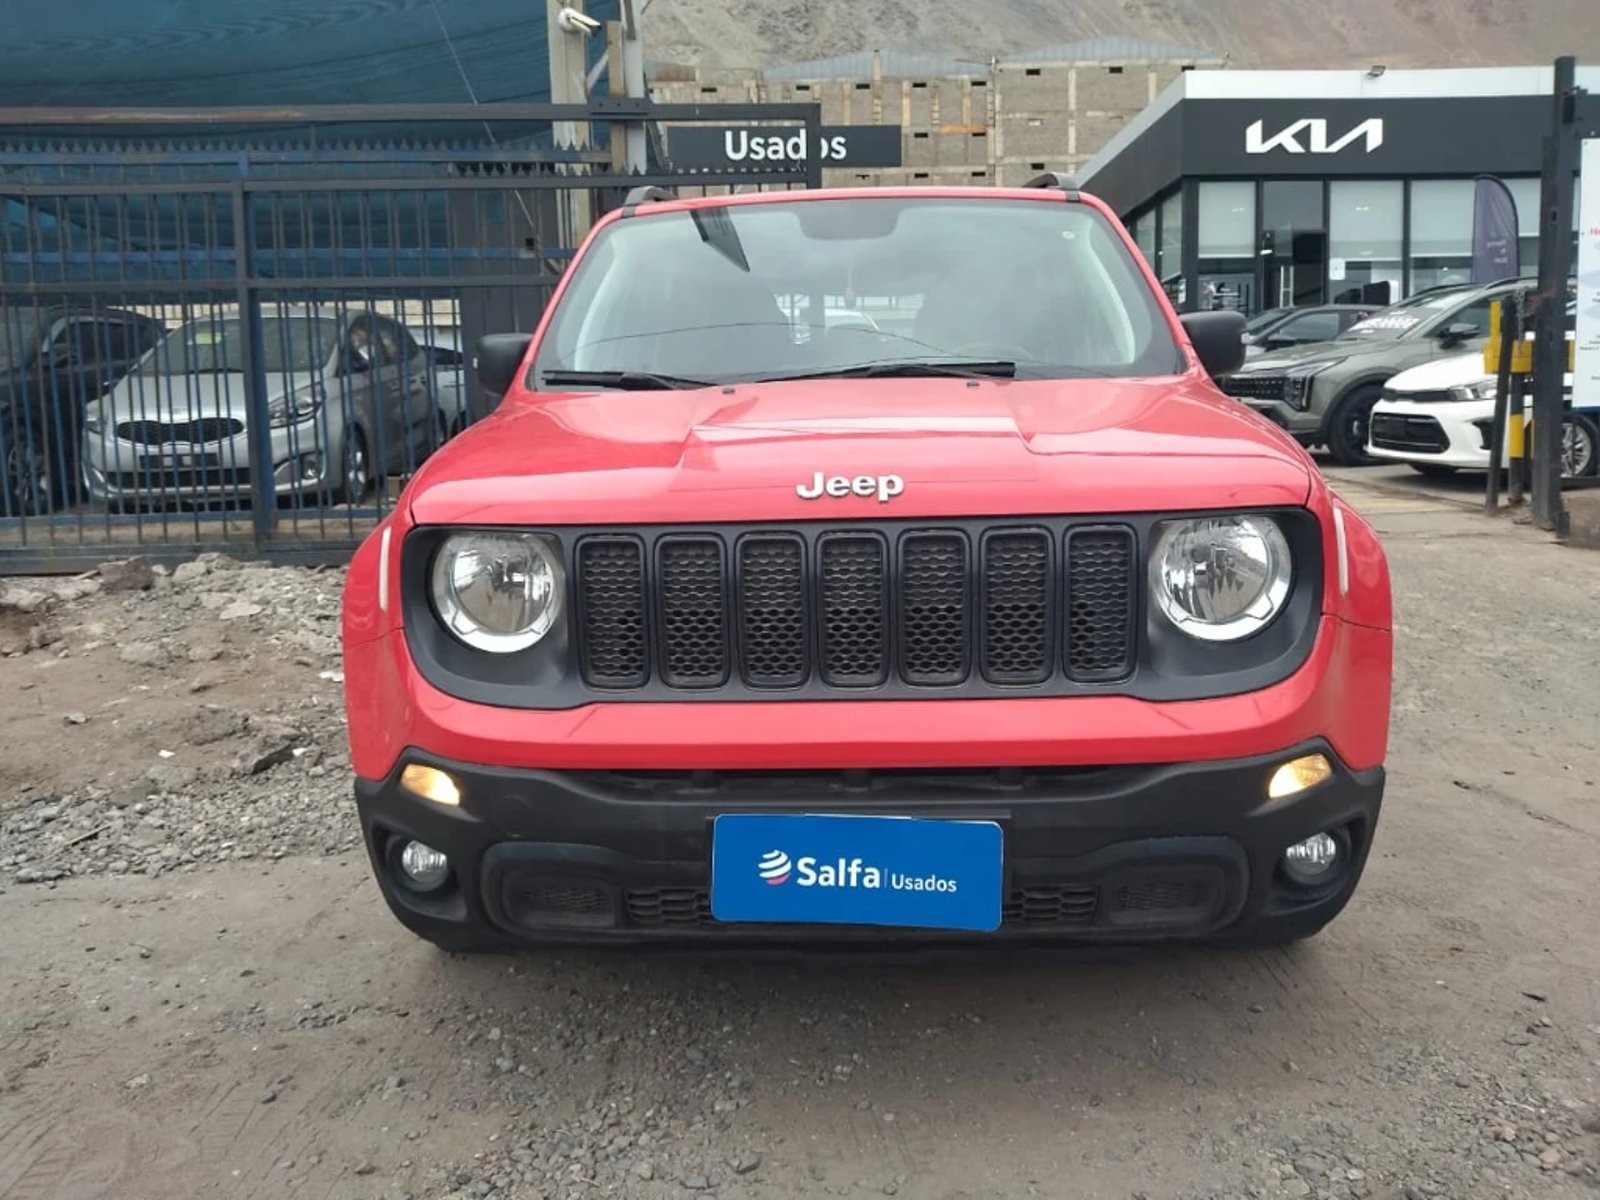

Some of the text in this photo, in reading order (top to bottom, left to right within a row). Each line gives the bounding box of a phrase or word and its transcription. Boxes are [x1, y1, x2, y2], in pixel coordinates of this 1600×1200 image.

[1245, 118, 1383, 154] KIA
[796, 471, 905, 503] Jeep
[796, 856, 957, 893] Salfa Usados
